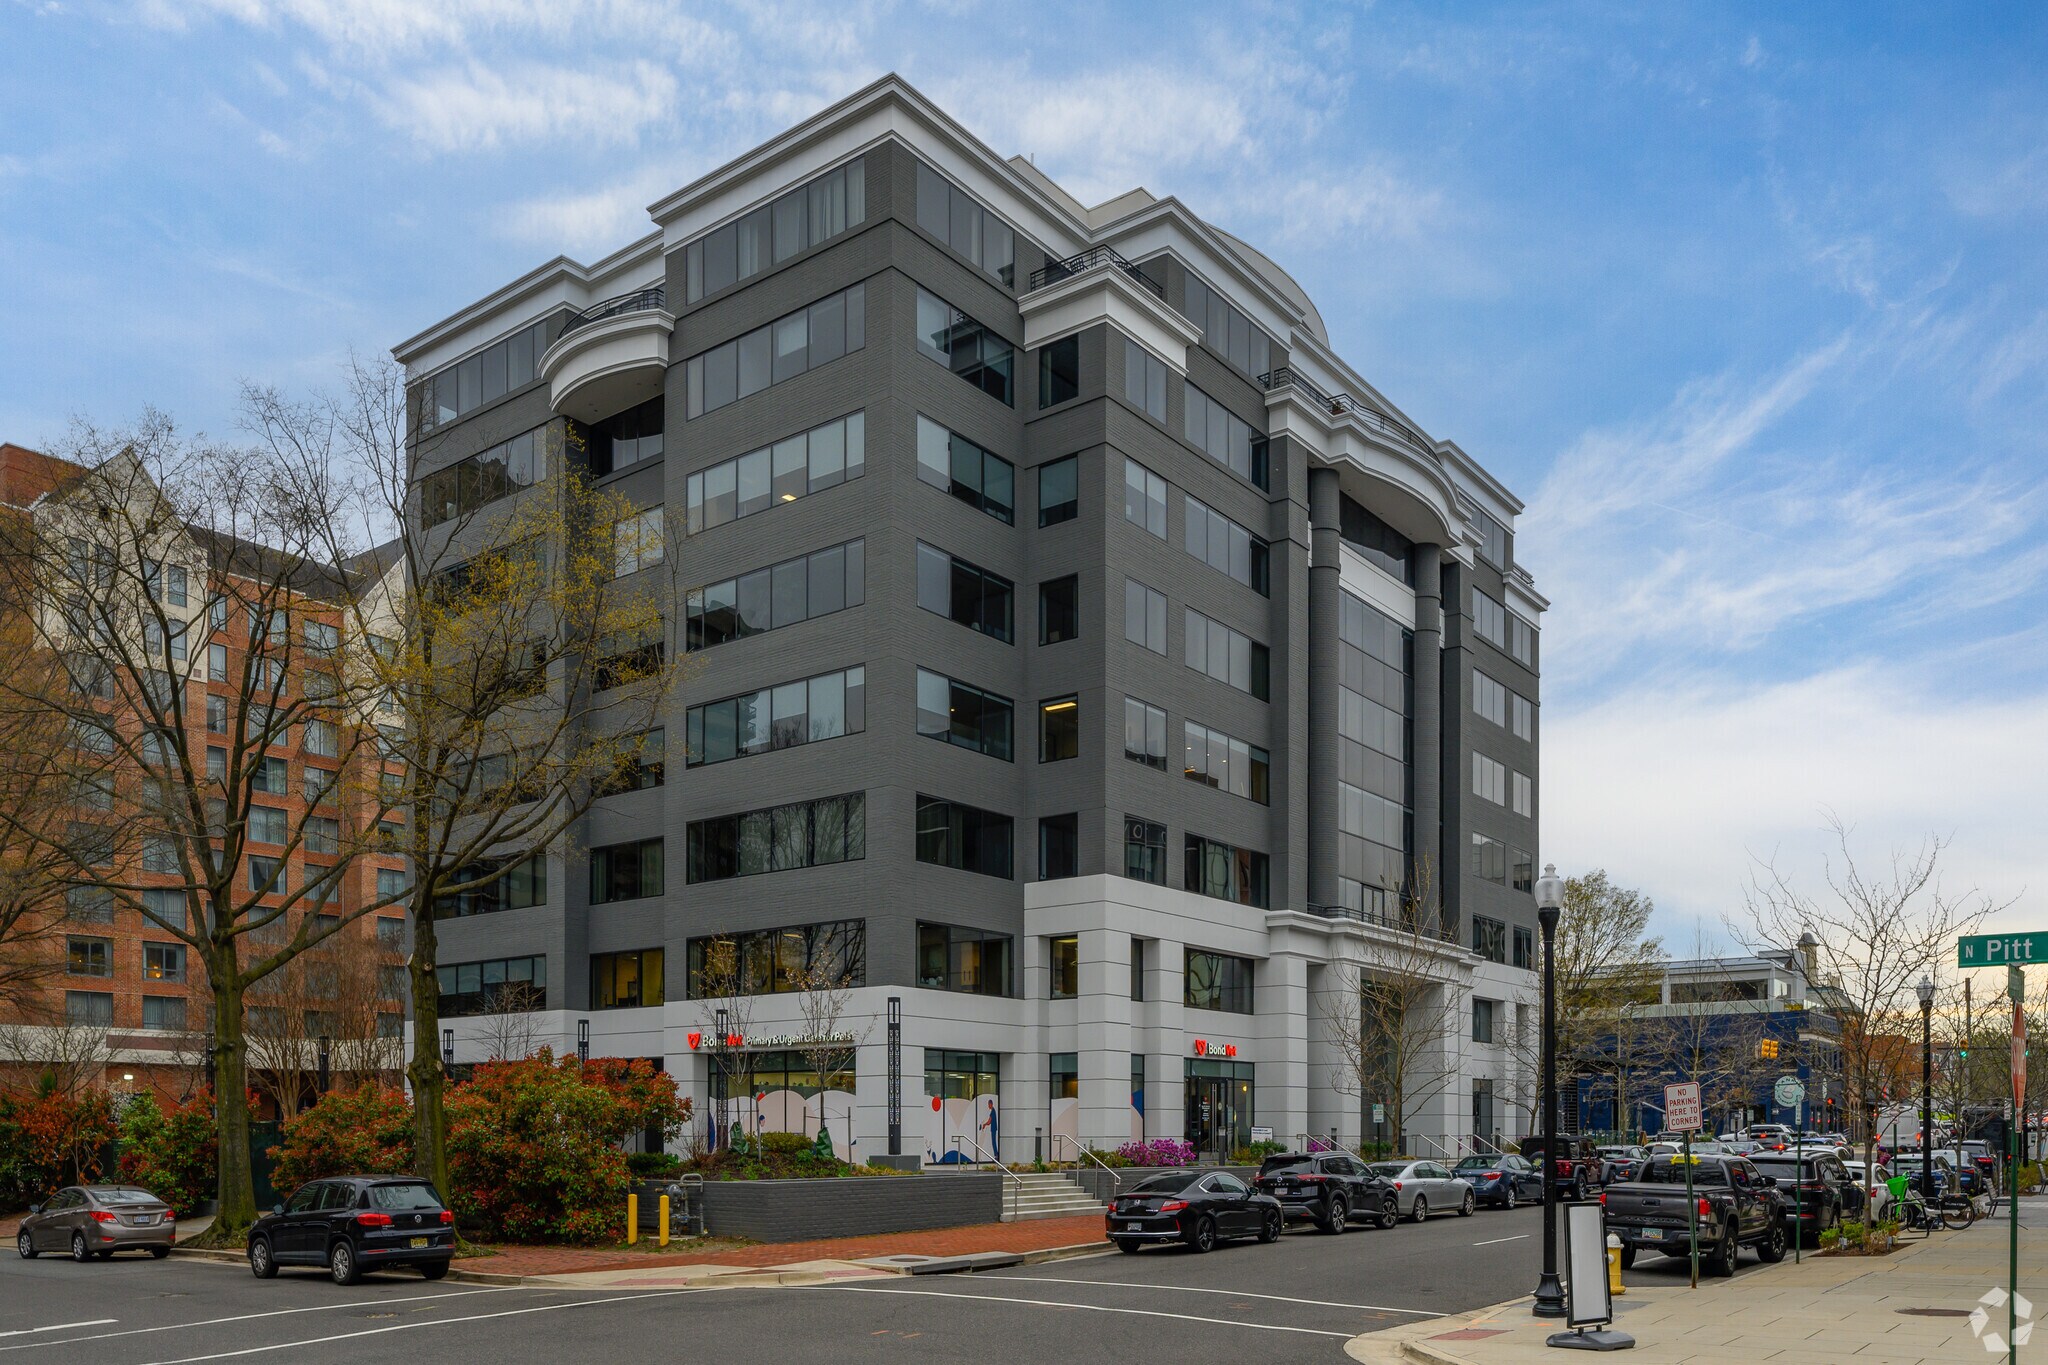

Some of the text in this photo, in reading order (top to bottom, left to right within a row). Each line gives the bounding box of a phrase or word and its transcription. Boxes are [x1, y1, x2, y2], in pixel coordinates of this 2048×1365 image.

[1965, 938, 2033, 961] N Pitt
[746, 1036, 772, 1047] Primary
[779, 1034, 804, 1046] Urgent
[834, 1031, 852, 1041] Pets
[1677, 1088, 1687, 1097] NO
[1669, 1097, 1697, 1107] PARKING
[1670, 1106, 1698, 1116] HERE TO
[1671, 1116, 1698, 1126] CORNER
